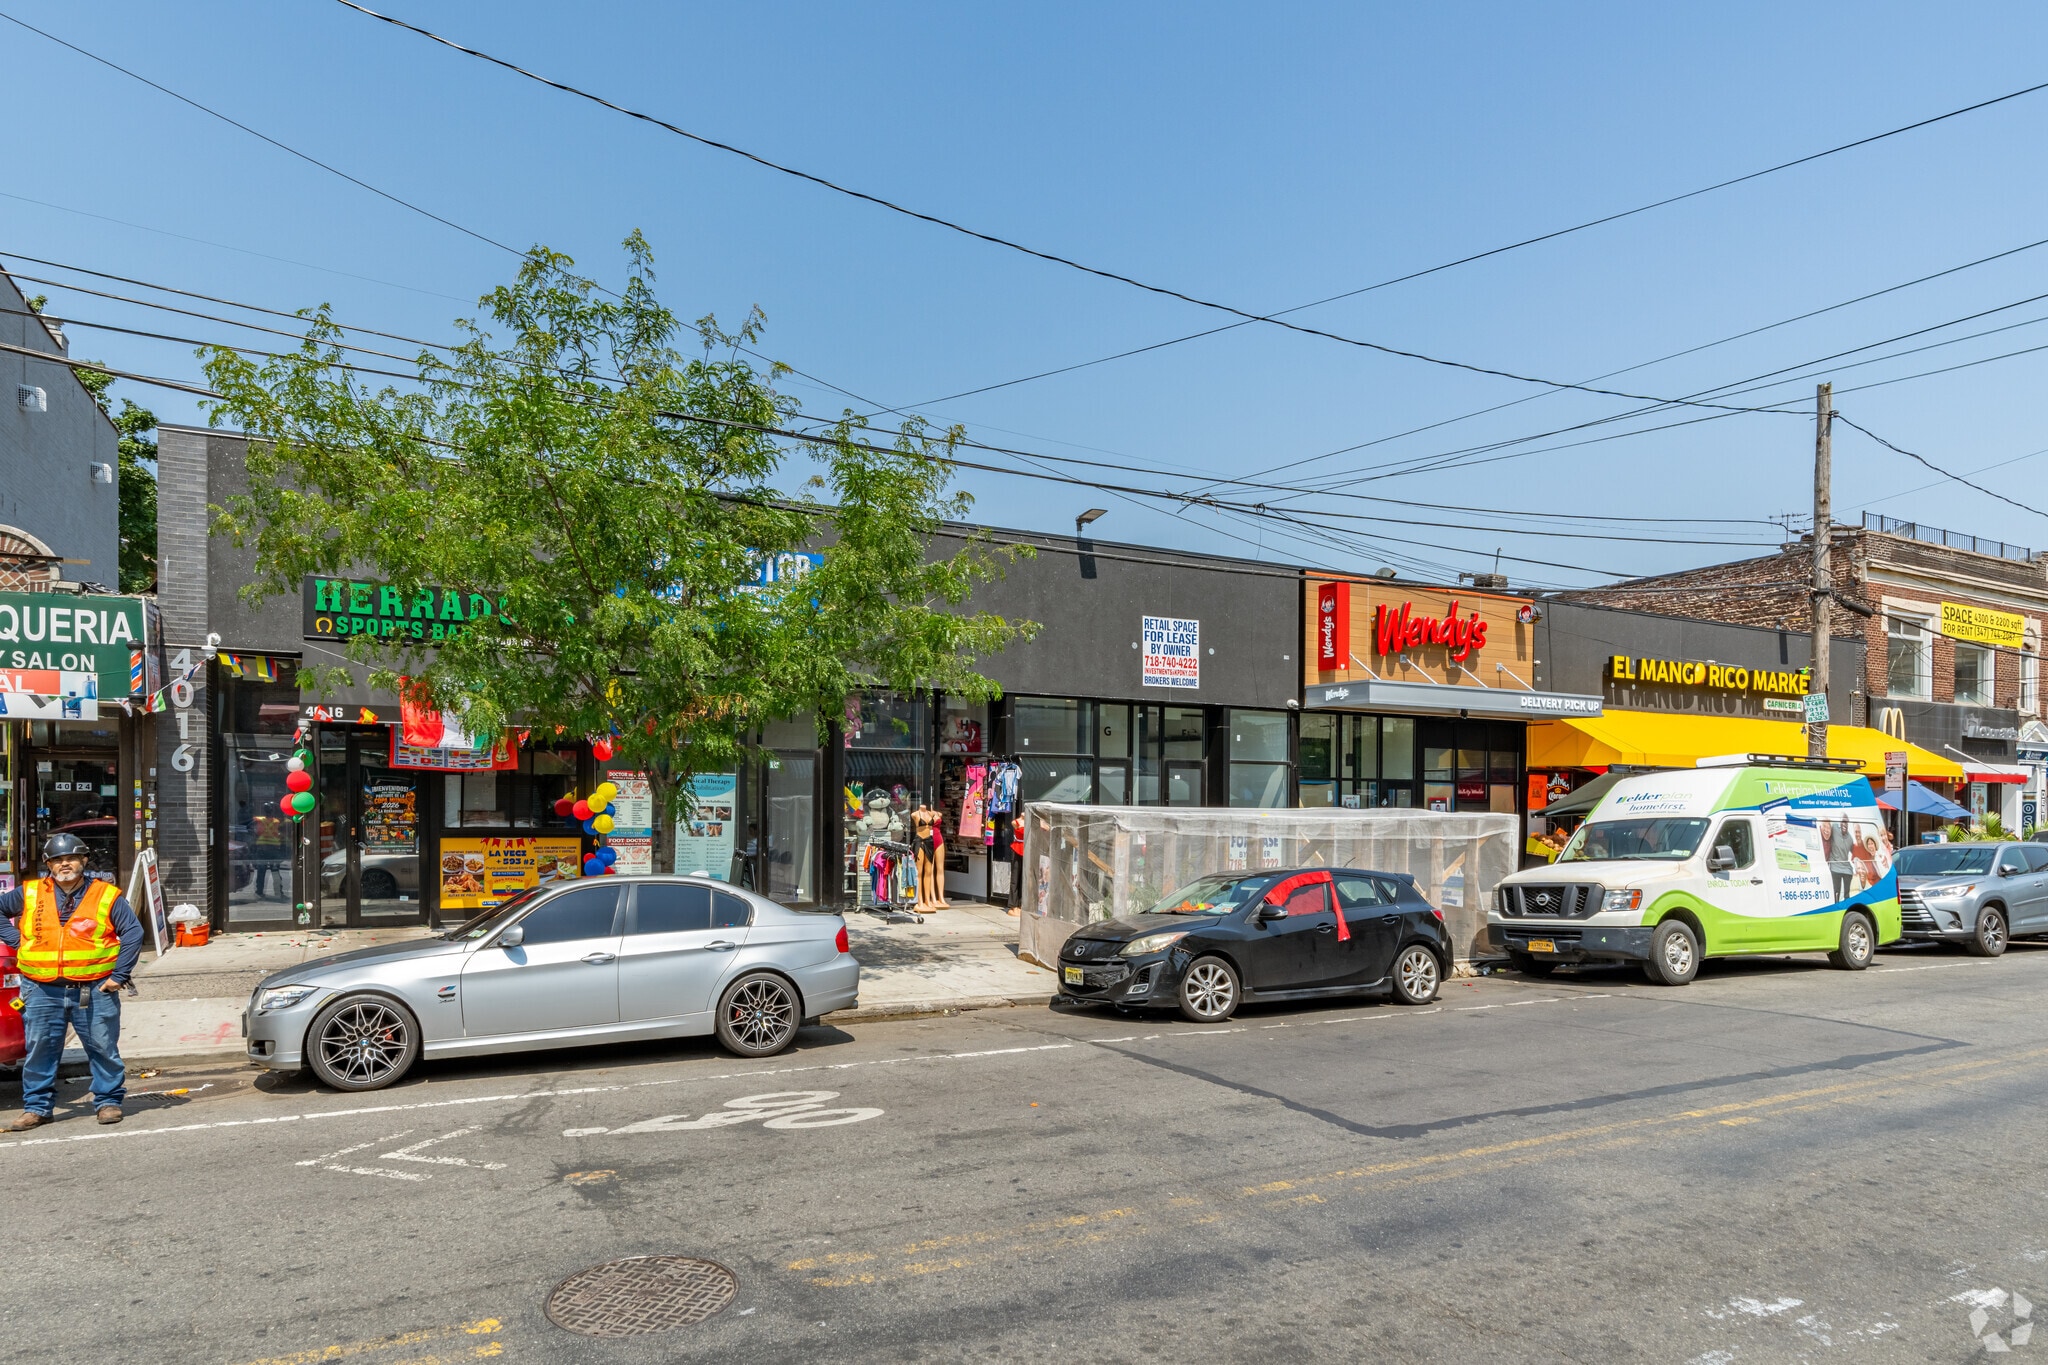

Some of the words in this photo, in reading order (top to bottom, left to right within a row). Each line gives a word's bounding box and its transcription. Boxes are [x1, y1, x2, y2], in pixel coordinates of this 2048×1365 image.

[1944, 606, 1972, 625] SPACE
[1974, 613, 1988, 625] 4300
[1990, 615, 1995, 625] &
[1996, 617, 2009, 628] 2200
[2011, 620, 2022, 631] sqft
[336, 616, 424, 639] SPORTS
[431, 623, 468, 641] BA
[1144, 618, 1171, 631] RETAIL
[1173, 621, 1197, 633] SPACE
[1377, 600, 1488, 663] Wendy's
[1943, 622, 1956, 633] FOR
[1957, 625, 1973, 636] RENT
[1974, 625, 1990, 639] (347)
[1144, 631, 1163, 642] FOR
[1167, 632, 1197, 645] LEASE
[1323, 616, 1335, 658] Wendy's
[1151, 643, 1161, 654] BY
[1163, 644, 1190, 656] OWNER
[11, 650, 95, 671] SALON
[1145, 656, 1197, 669] 718-740-4222
[1145, 676, 1170, 685] BROKERS
[1171, 678, 1197, 687] WELCOME
[1613, 655, 1635, 679] EL
[1640, 657, 1706, 685] MANGO
[1709, 665, 1749, 689] RICO
[1753, 669, 1811, 695] MARKE
[1520, 695, 1562, 710] DELIVERY
[1564, 698, 1586, 711] PICK
[1588, 701, 1600, 712] UP
[1766, 700, 1802, 710] CARNICERIA
[1104, 726, 1111, 736] G
[708, 778, 730, 786] Therapy
[91, 871, 112, 879] Salon
[1782, 876, 1820, 885] elderplan.org
[1707, 880, 1729, 888] ENROLL
[1779, 890, 1830, 901] 1-866-695-8110
